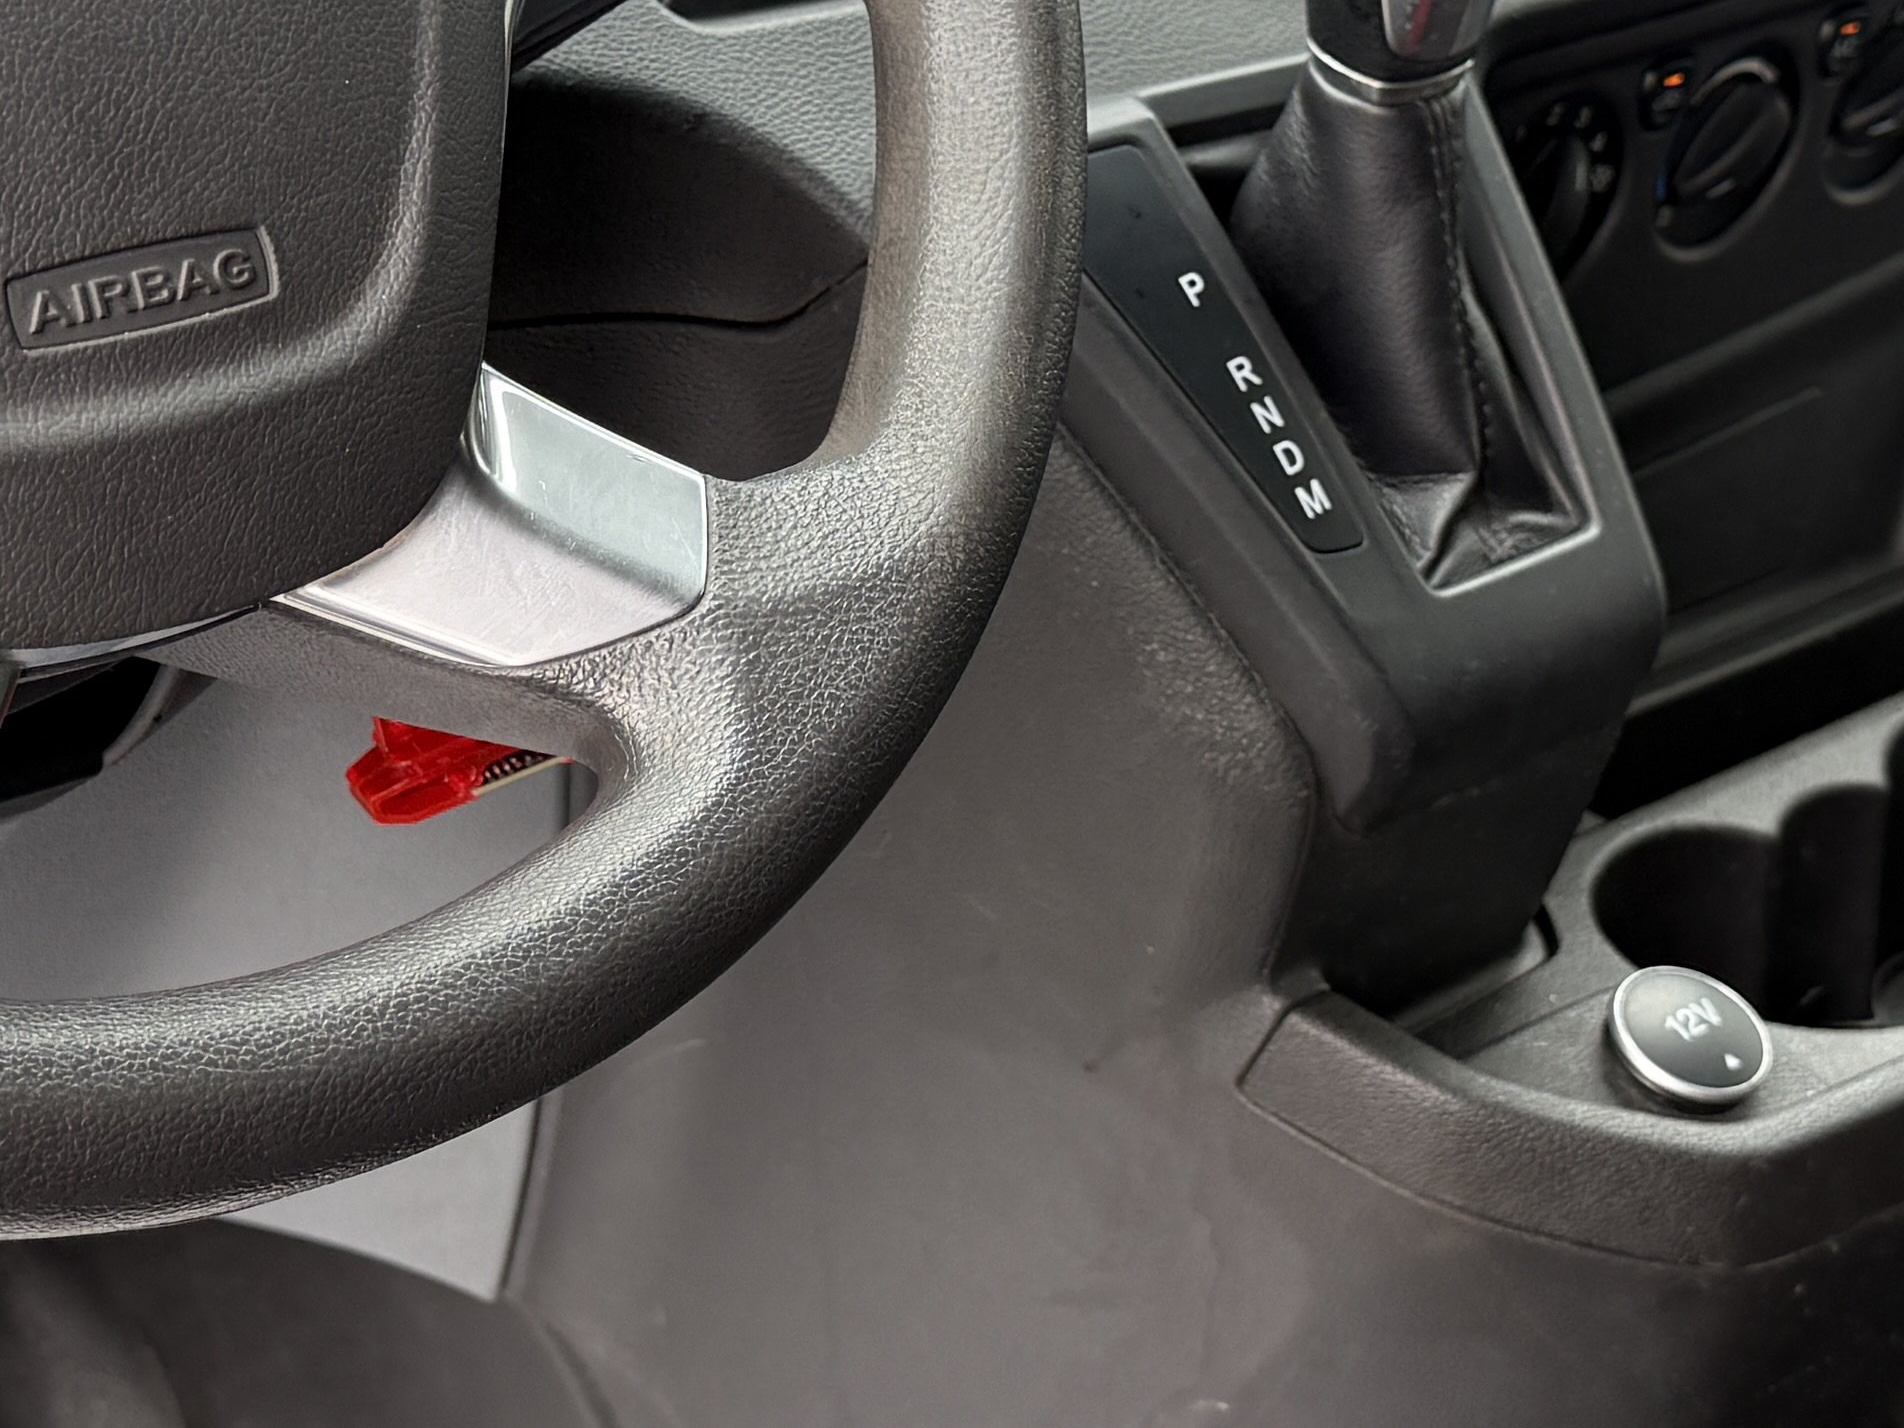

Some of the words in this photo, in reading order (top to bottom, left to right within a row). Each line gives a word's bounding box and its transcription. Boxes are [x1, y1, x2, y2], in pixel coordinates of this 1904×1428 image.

[29, 248, 257, 335] AIRBAG
[1178, 272, 1205, 307] P
[1226, 356, 1263, 392] R
[1250, 396, 1285, 434] N
[1272, 439, 1305, 476] D
[1294, 478, 1332, 519] M
[1665, 997, 1723, 1042] 12V
